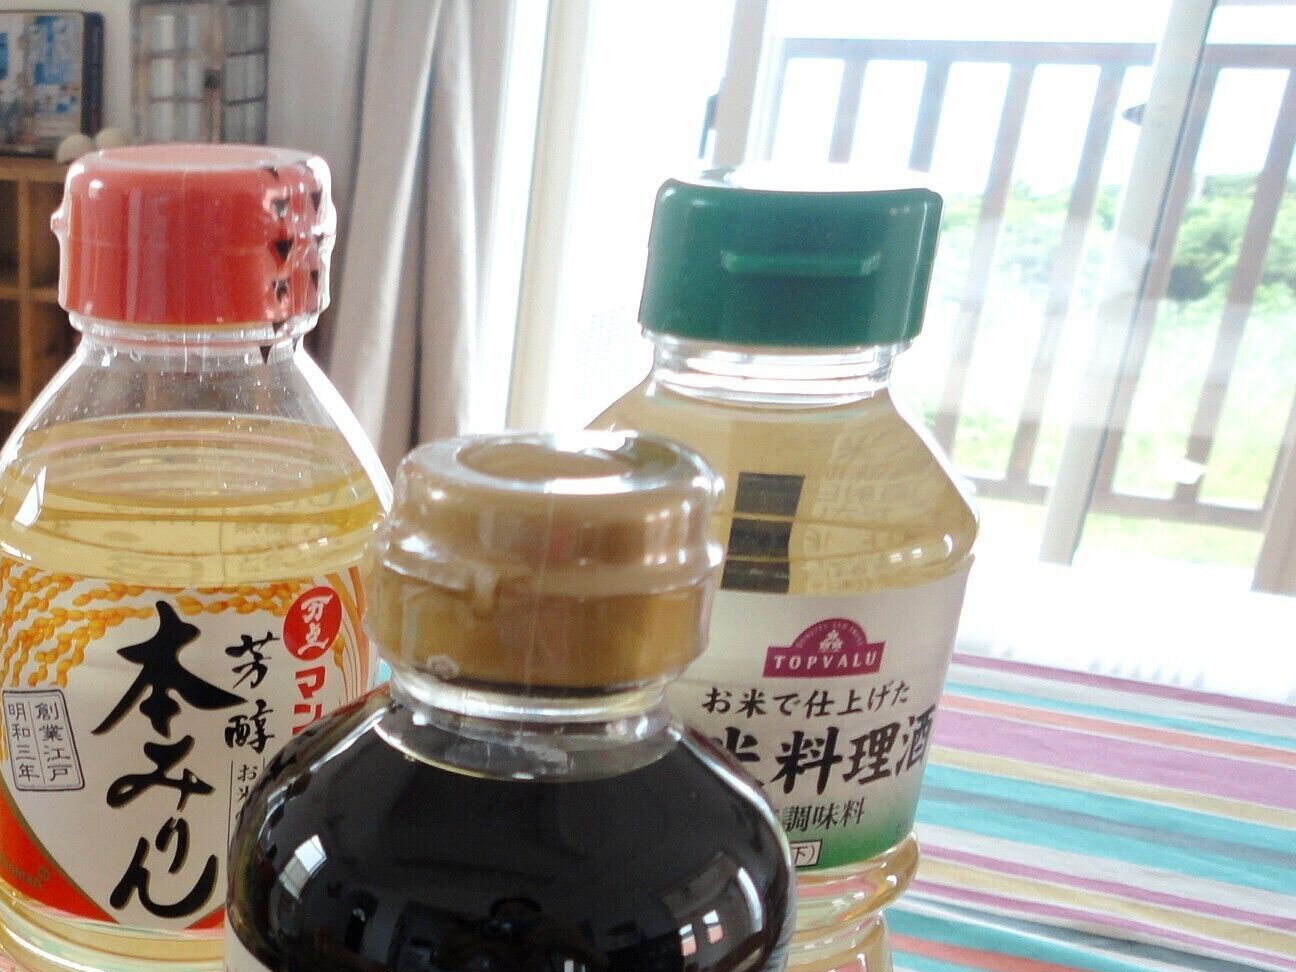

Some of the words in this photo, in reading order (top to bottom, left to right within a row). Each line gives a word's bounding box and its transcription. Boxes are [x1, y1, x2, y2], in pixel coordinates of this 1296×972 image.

[224, 630, 281, 755] 芳醇
[773, 650, 877, 671] TOPVALU
[292, 665, 327, 737] マン
[701, 679, 910, 720] お米で仕上げた
[91, 600, 249, 919] 本みりん
